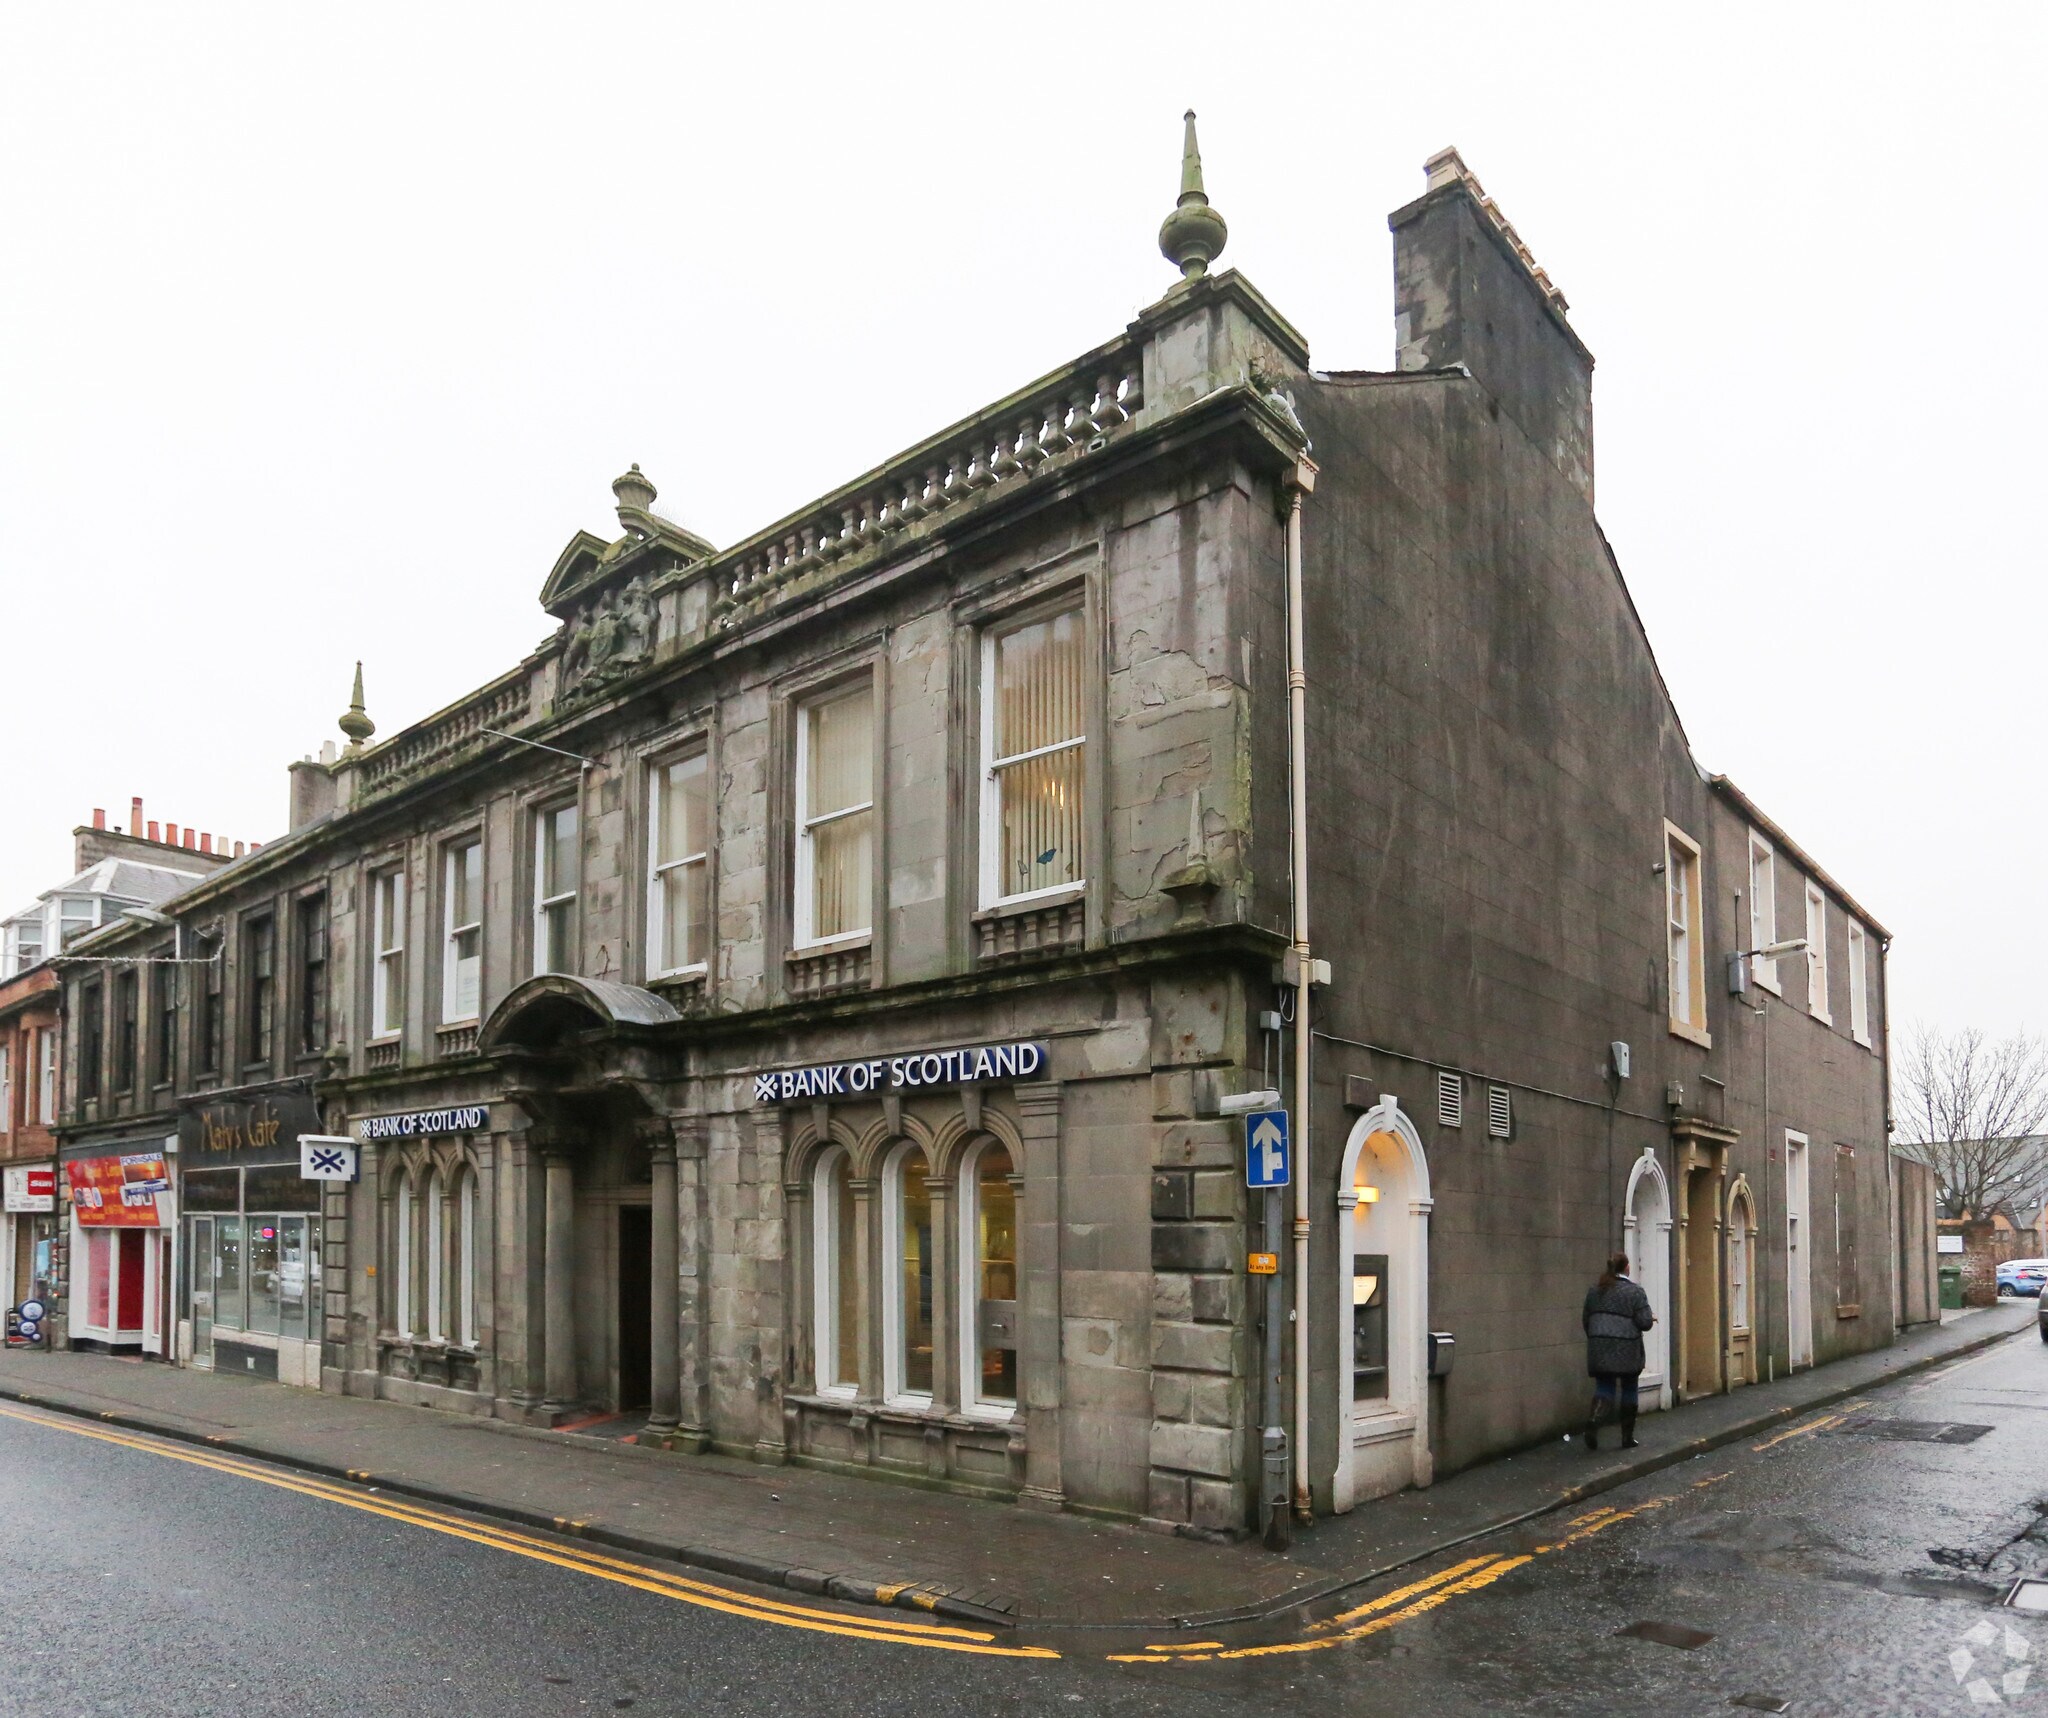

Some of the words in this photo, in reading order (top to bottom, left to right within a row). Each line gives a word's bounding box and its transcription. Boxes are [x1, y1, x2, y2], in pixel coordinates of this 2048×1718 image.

[781, 1067, 845, 1099] BANK
[849, 1060, 885, 1092] OF
[891, 1043, 1040, 1087] SCOTLAND
[372, 1117, 401, 1138] BANK
[402, 1115, 417, 1134] OF
[420, 1107, 481, 1133] SCOTLAND
[121, 1156, 136, 1165] FOR
